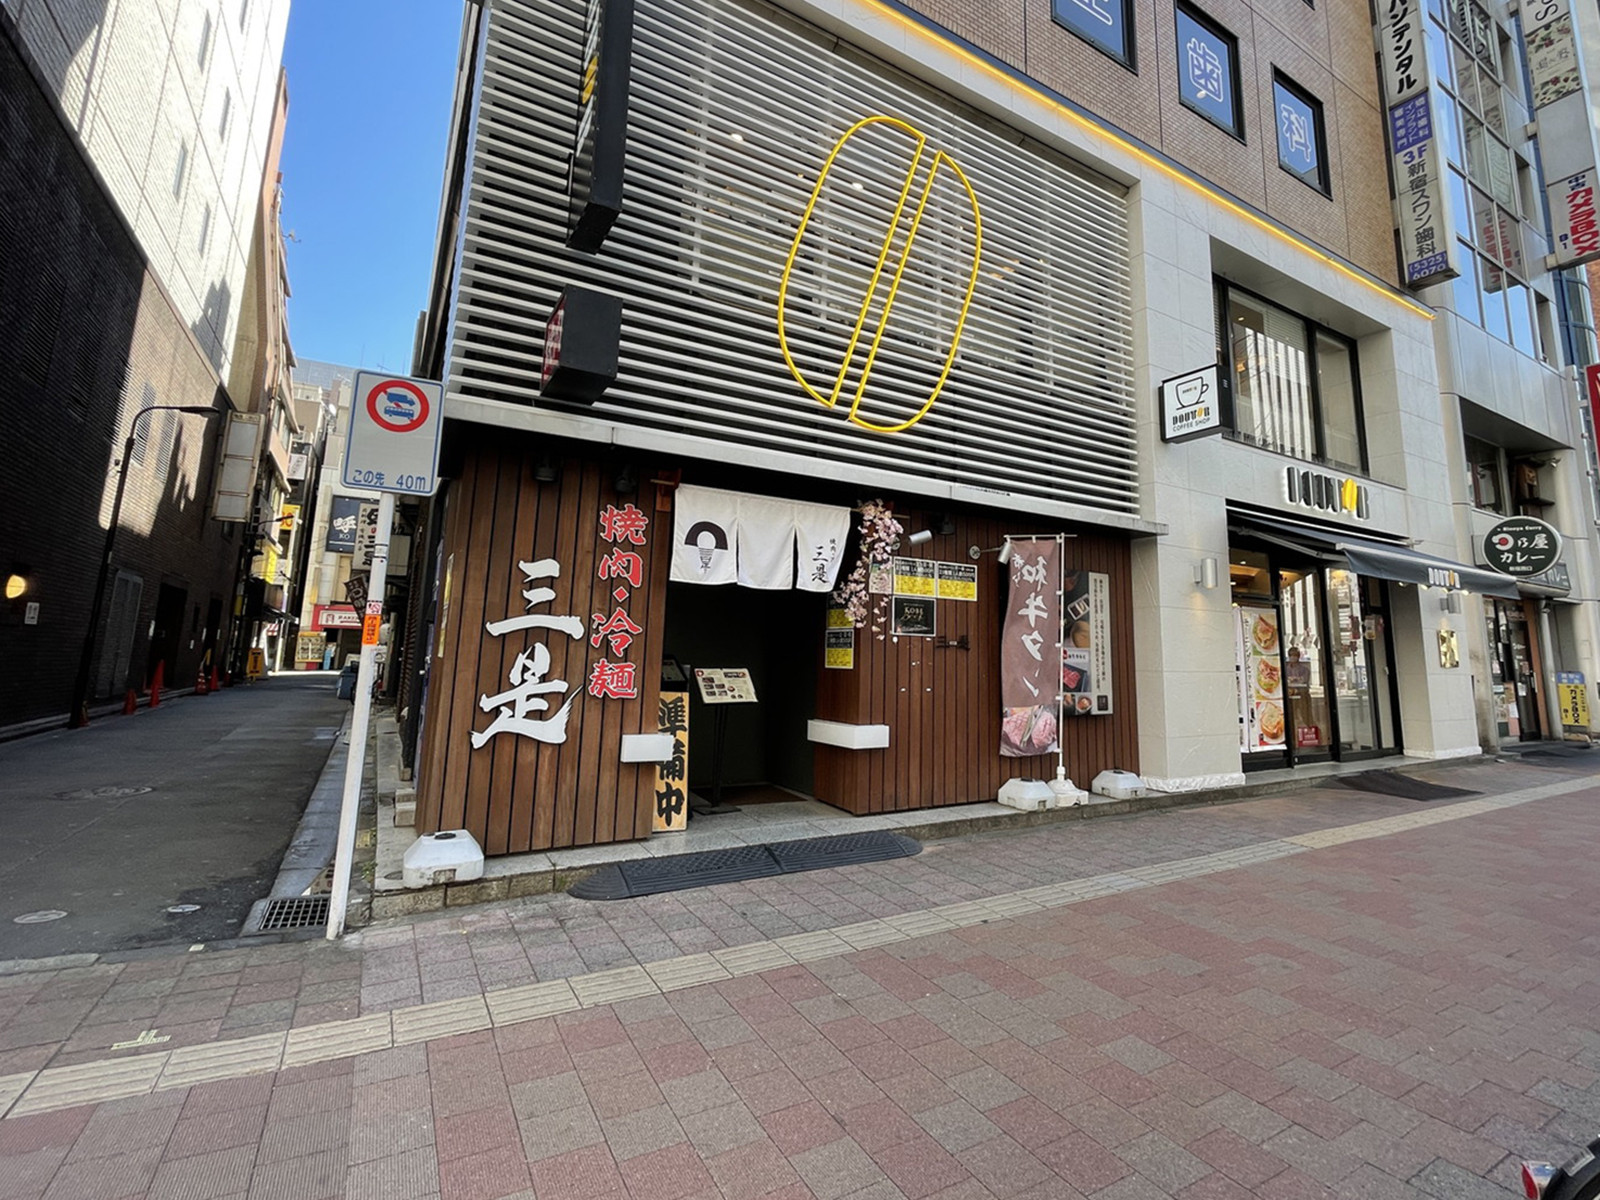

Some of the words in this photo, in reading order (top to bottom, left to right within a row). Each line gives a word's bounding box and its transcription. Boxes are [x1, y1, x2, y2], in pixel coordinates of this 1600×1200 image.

[1403, 143, 1427, 165] 3F
[1407, 160, 1436, 259] 新宿スワン歯科
[1409, 252, 1447, 273] (5325)
[1412, 263, 1446, 280] 6070
[1172, 406, 1210, 425] DOUTOR
[1172, 421, 1193, 432] COFFEE
[1194, 417, 1211, 426] SHOP
[352, 469, 385, 486] この先
[395, 473, 427, 490] 40m
[1500, 551, 1546, 563] カレー
